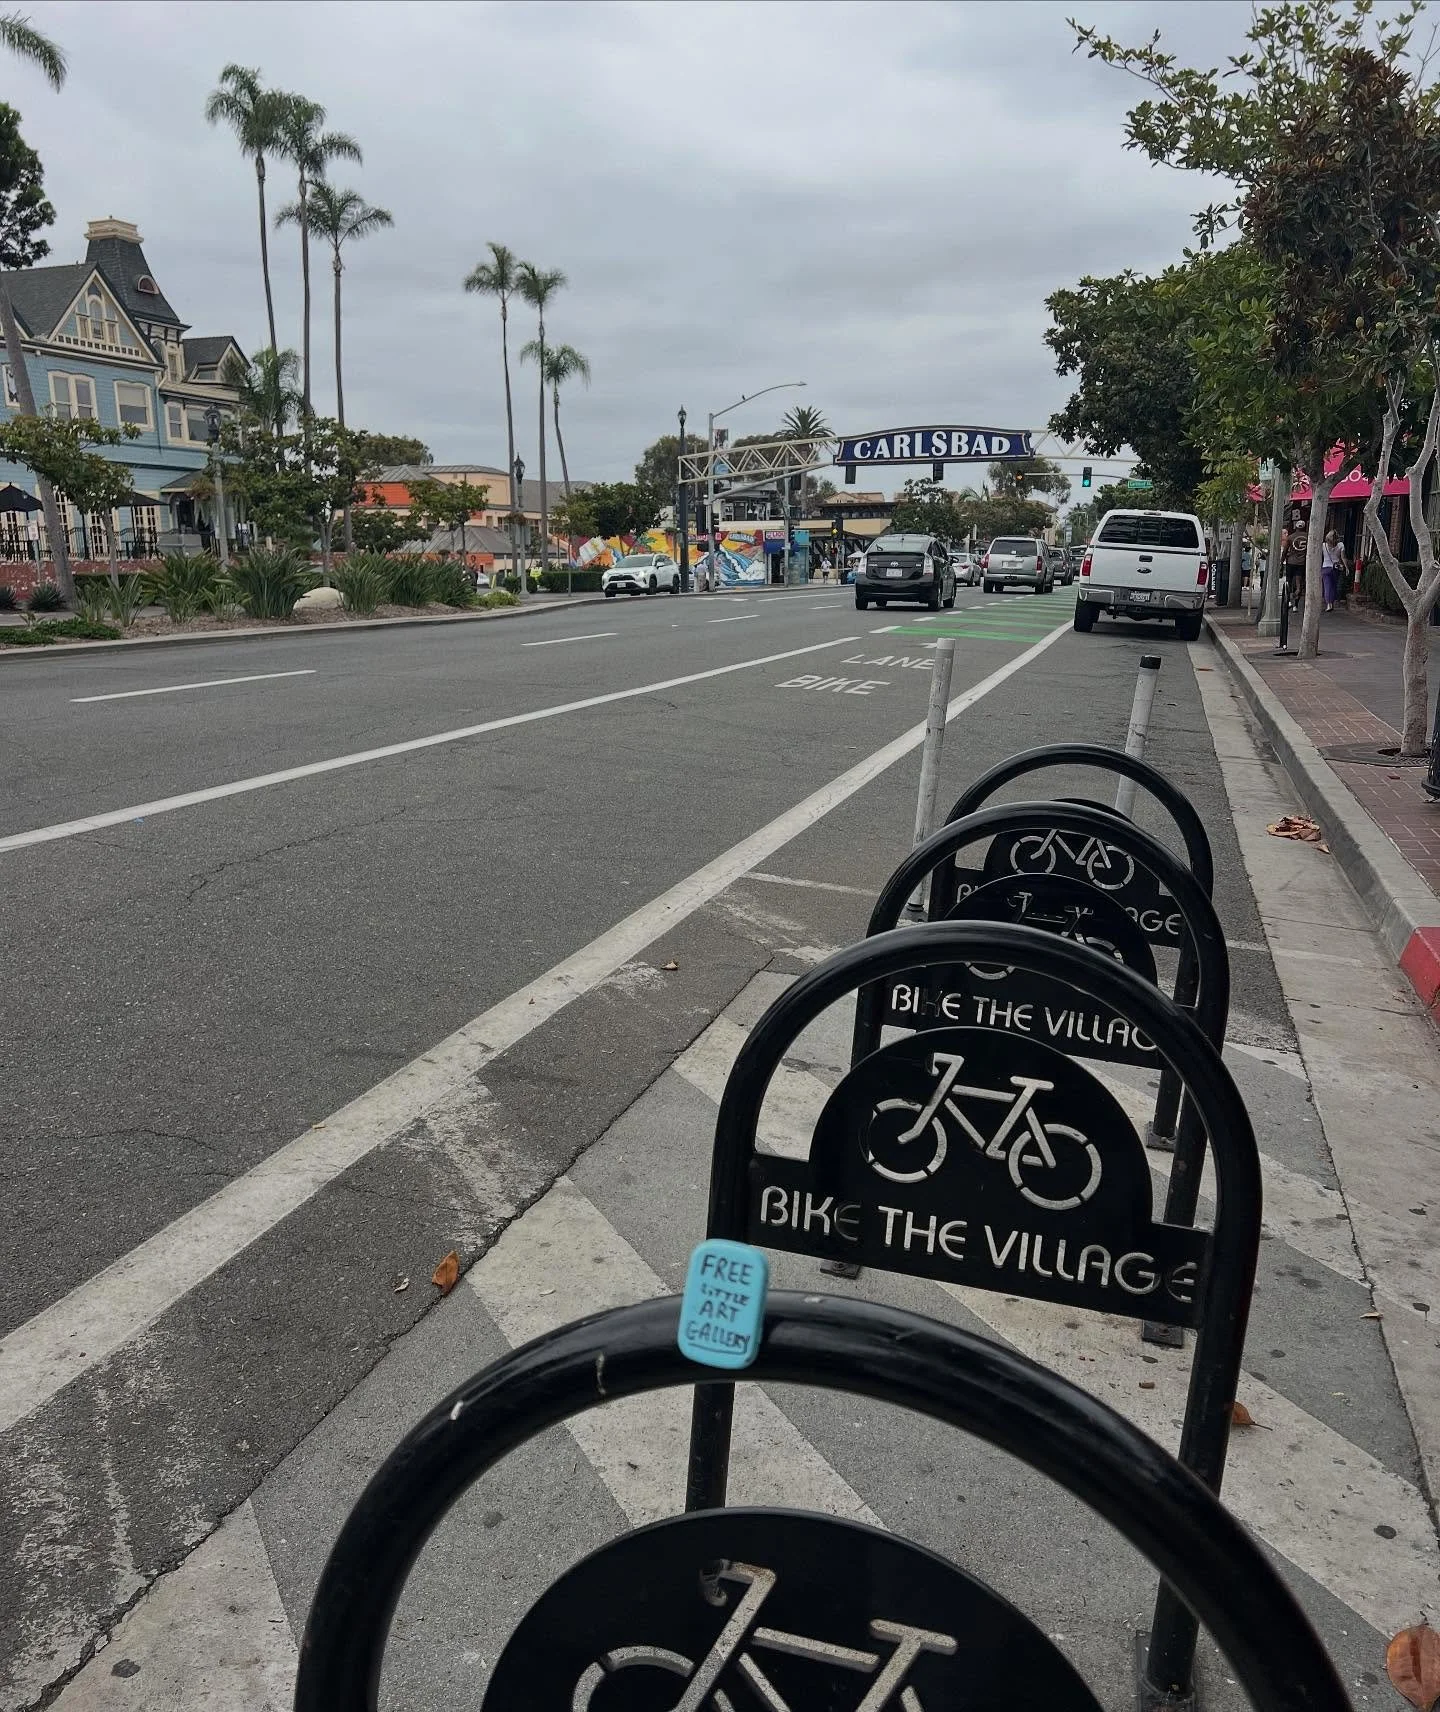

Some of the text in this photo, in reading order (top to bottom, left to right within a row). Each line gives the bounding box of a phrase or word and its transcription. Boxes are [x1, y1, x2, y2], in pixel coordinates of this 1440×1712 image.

[853, 430, 1011, 459] CARLSBAD
[841, 654, 936, 670] LANE
[774, 674, 891, 695] BIKE
[973, 995, 1034, 1031] THE
[1045, 1007, 1157, 1051] VILLA
[760, 1185, 1198, 1303] BIKE THE VILLAGE
[700, 1254, 752, 1285] FREE
[701, 1283, 749, 1306] LITTLE
[698, 1300, 740, 1323] ART
[686, 1320, 751, 1350] GALLERY
